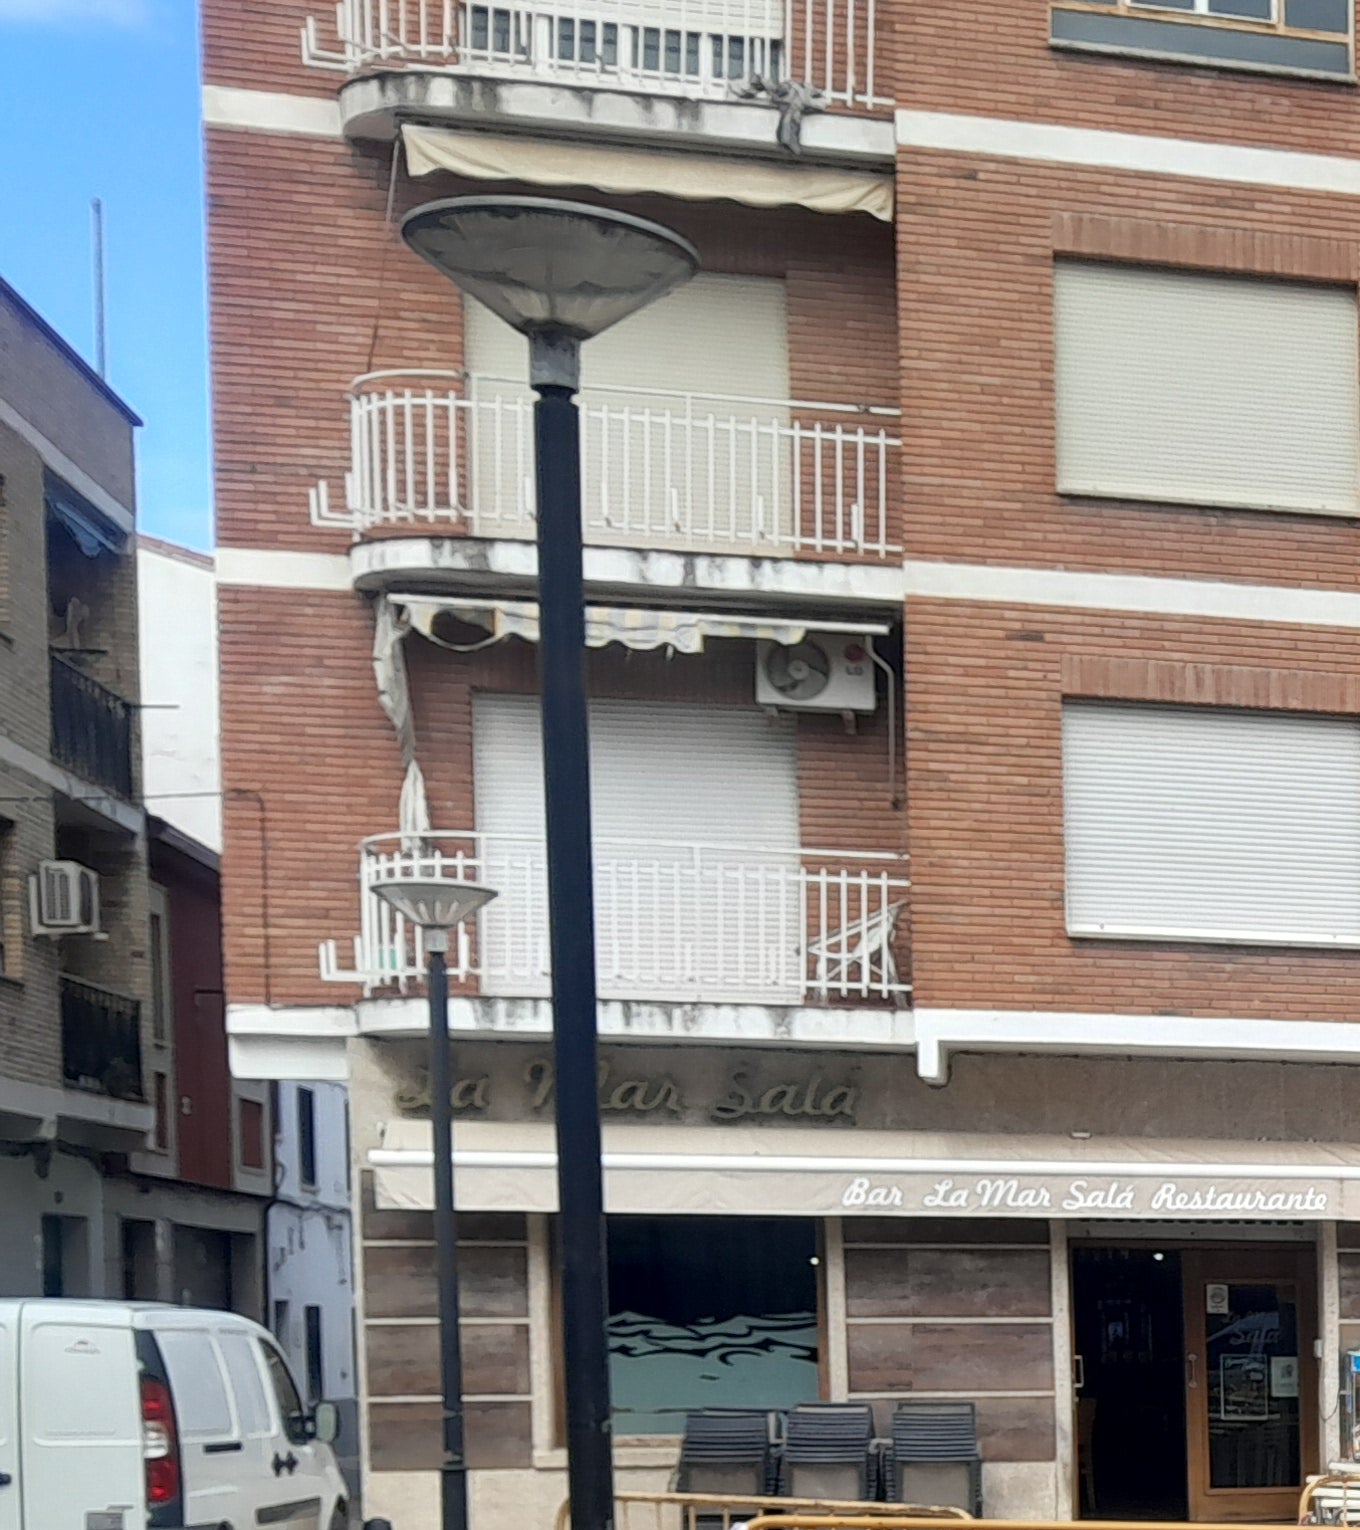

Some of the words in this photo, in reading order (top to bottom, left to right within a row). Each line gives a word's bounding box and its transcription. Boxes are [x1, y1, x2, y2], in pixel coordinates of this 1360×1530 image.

[843, 1178, 904, 1206] Bar
[922, 1179, 967, 1207] La
[975, 1180, 1052, 1210] Mar
[1061, 1180, 1135, 1211] Salá
[1150, 1182, 1328, 1212] Restaurante
